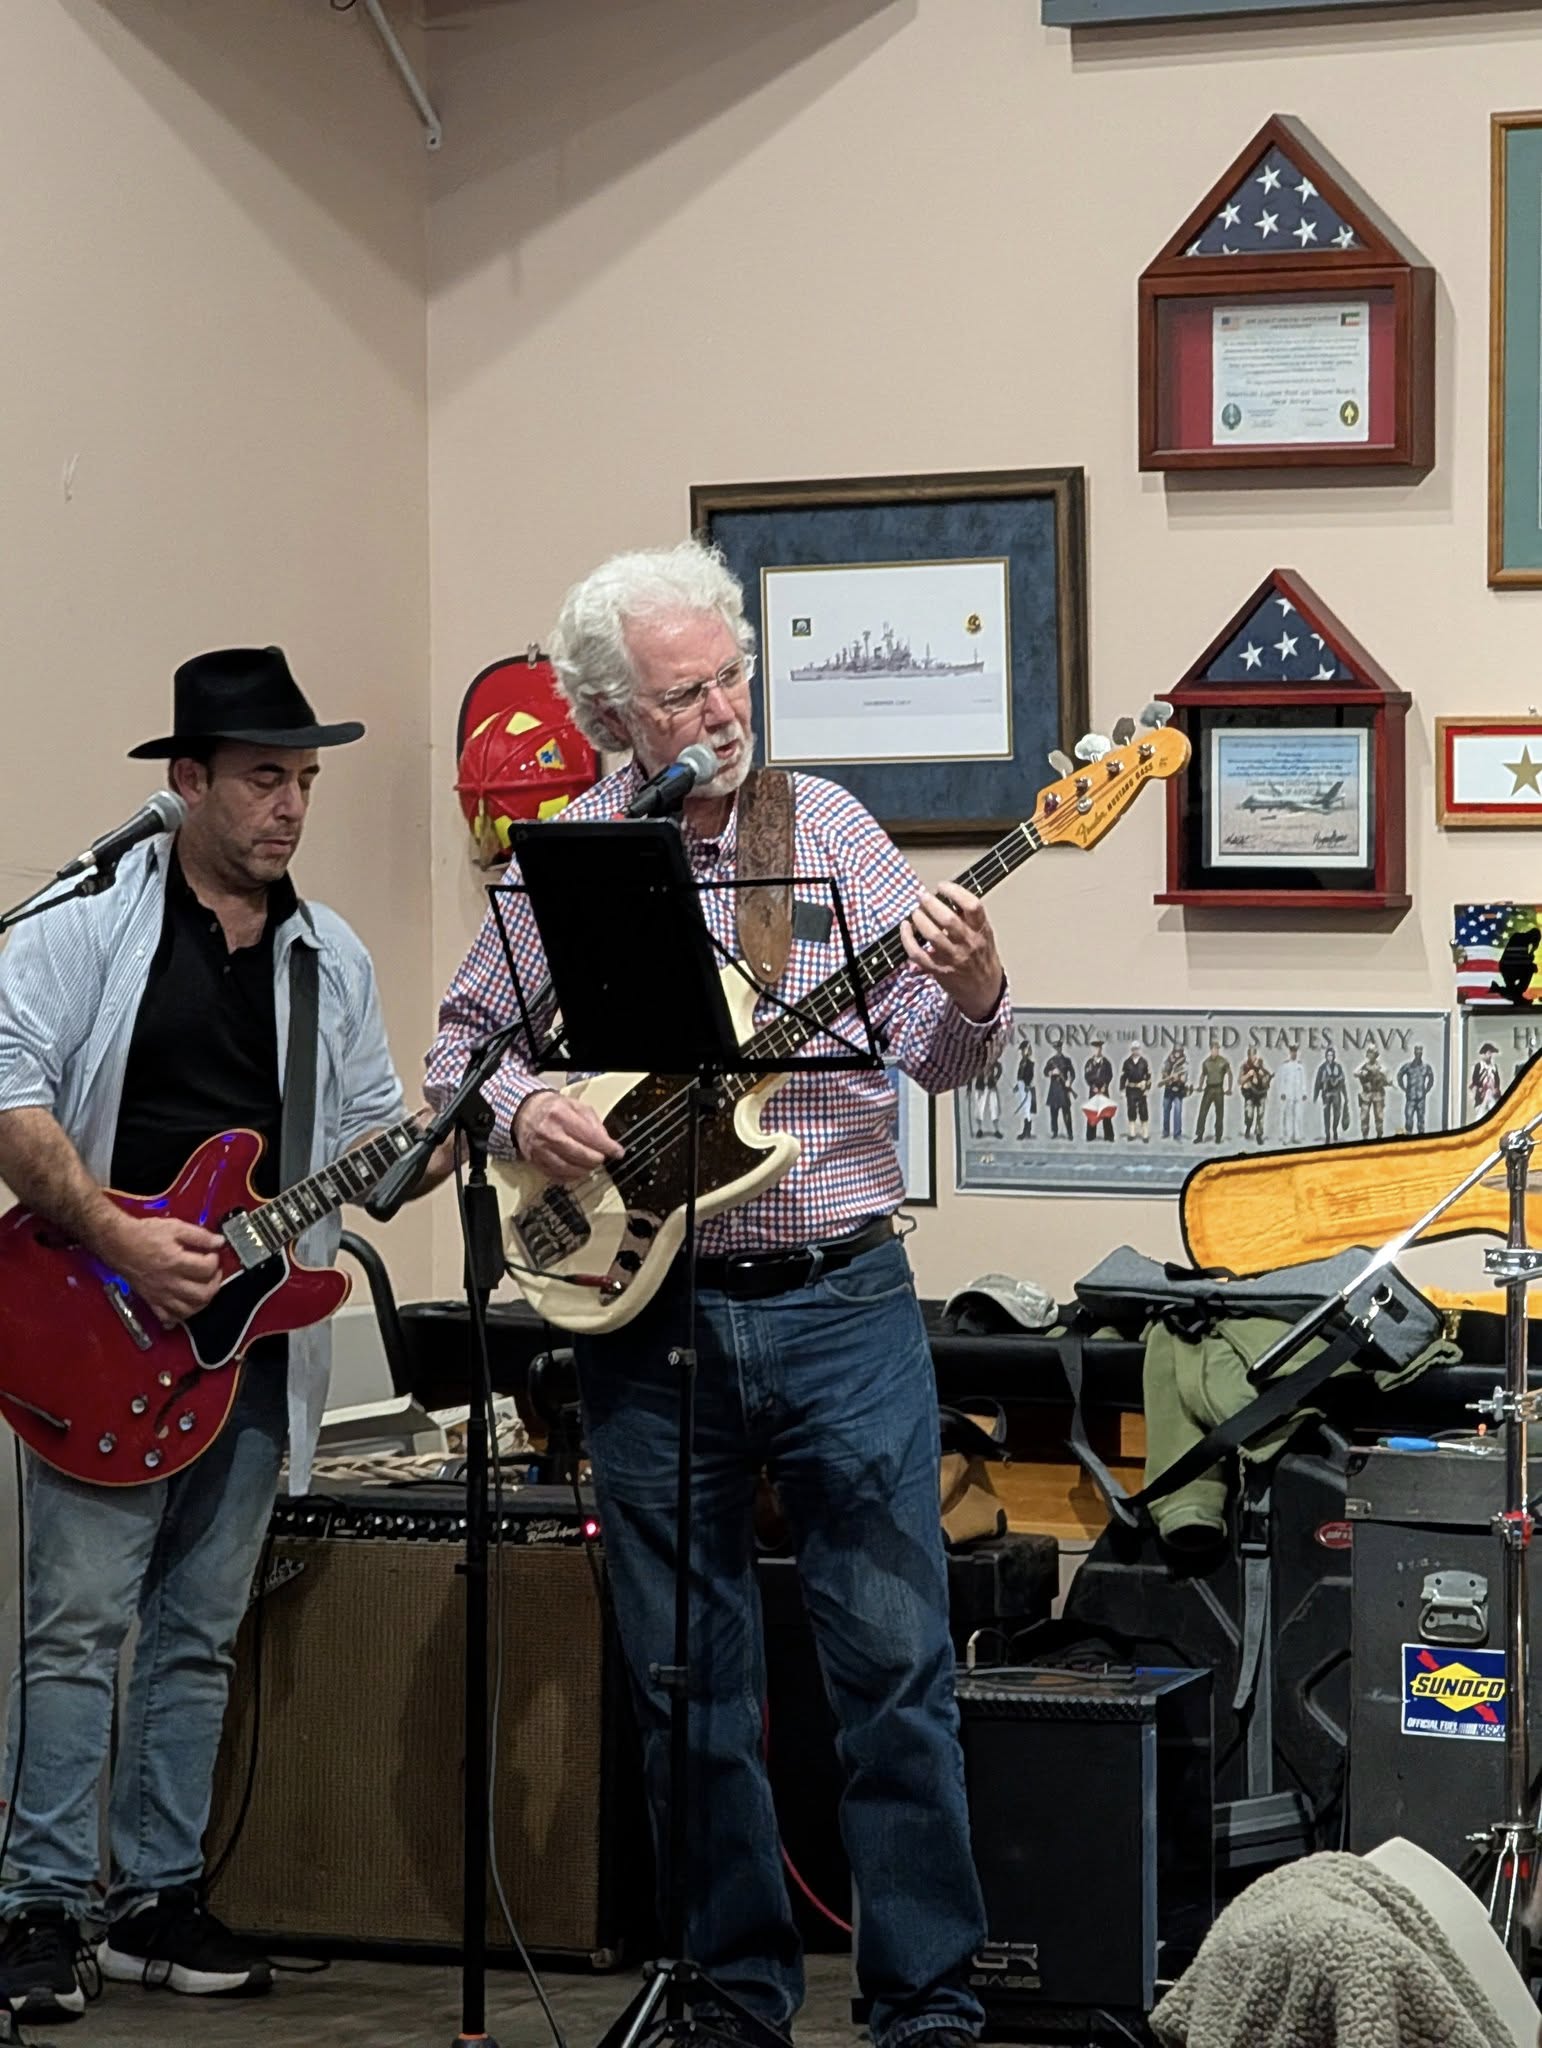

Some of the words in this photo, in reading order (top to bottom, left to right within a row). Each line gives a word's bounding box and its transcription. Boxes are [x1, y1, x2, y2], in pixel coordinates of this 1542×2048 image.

[1135, 763, 1154, 780] BASS
[1116, 1029, 1138, 1041] THE
[1142, 1025, 1241, 1049] UNITED
[1249, 1025, 1333, 1050] STATES
[1342, 1027, 1413, 1050] NAVY
[1415, 1676, 1504, 1698] SUNOCO
